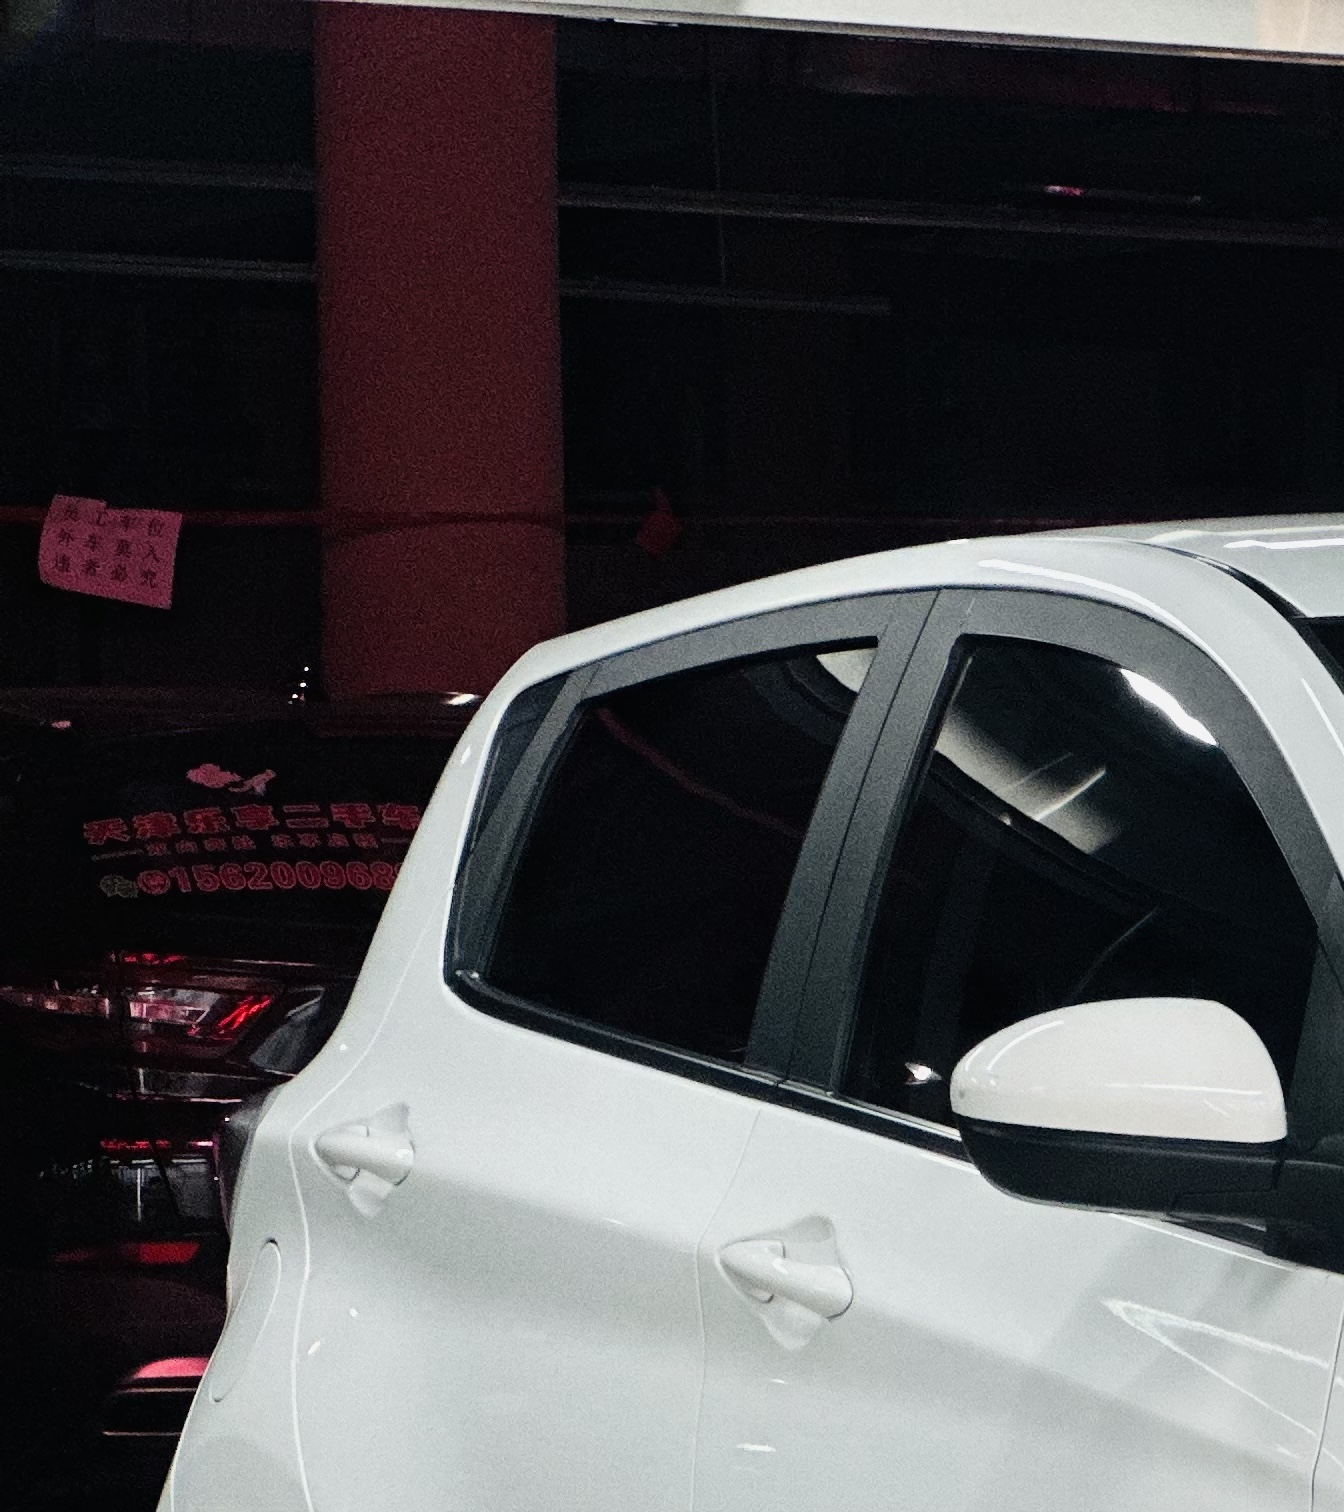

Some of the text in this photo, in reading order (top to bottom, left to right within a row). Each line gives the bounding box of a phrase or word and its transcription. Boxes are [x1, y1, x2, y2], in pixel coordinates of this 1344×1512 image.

[54, 554, 158, 588] 违者必究
[169, 861, 402, 893] 156200968
